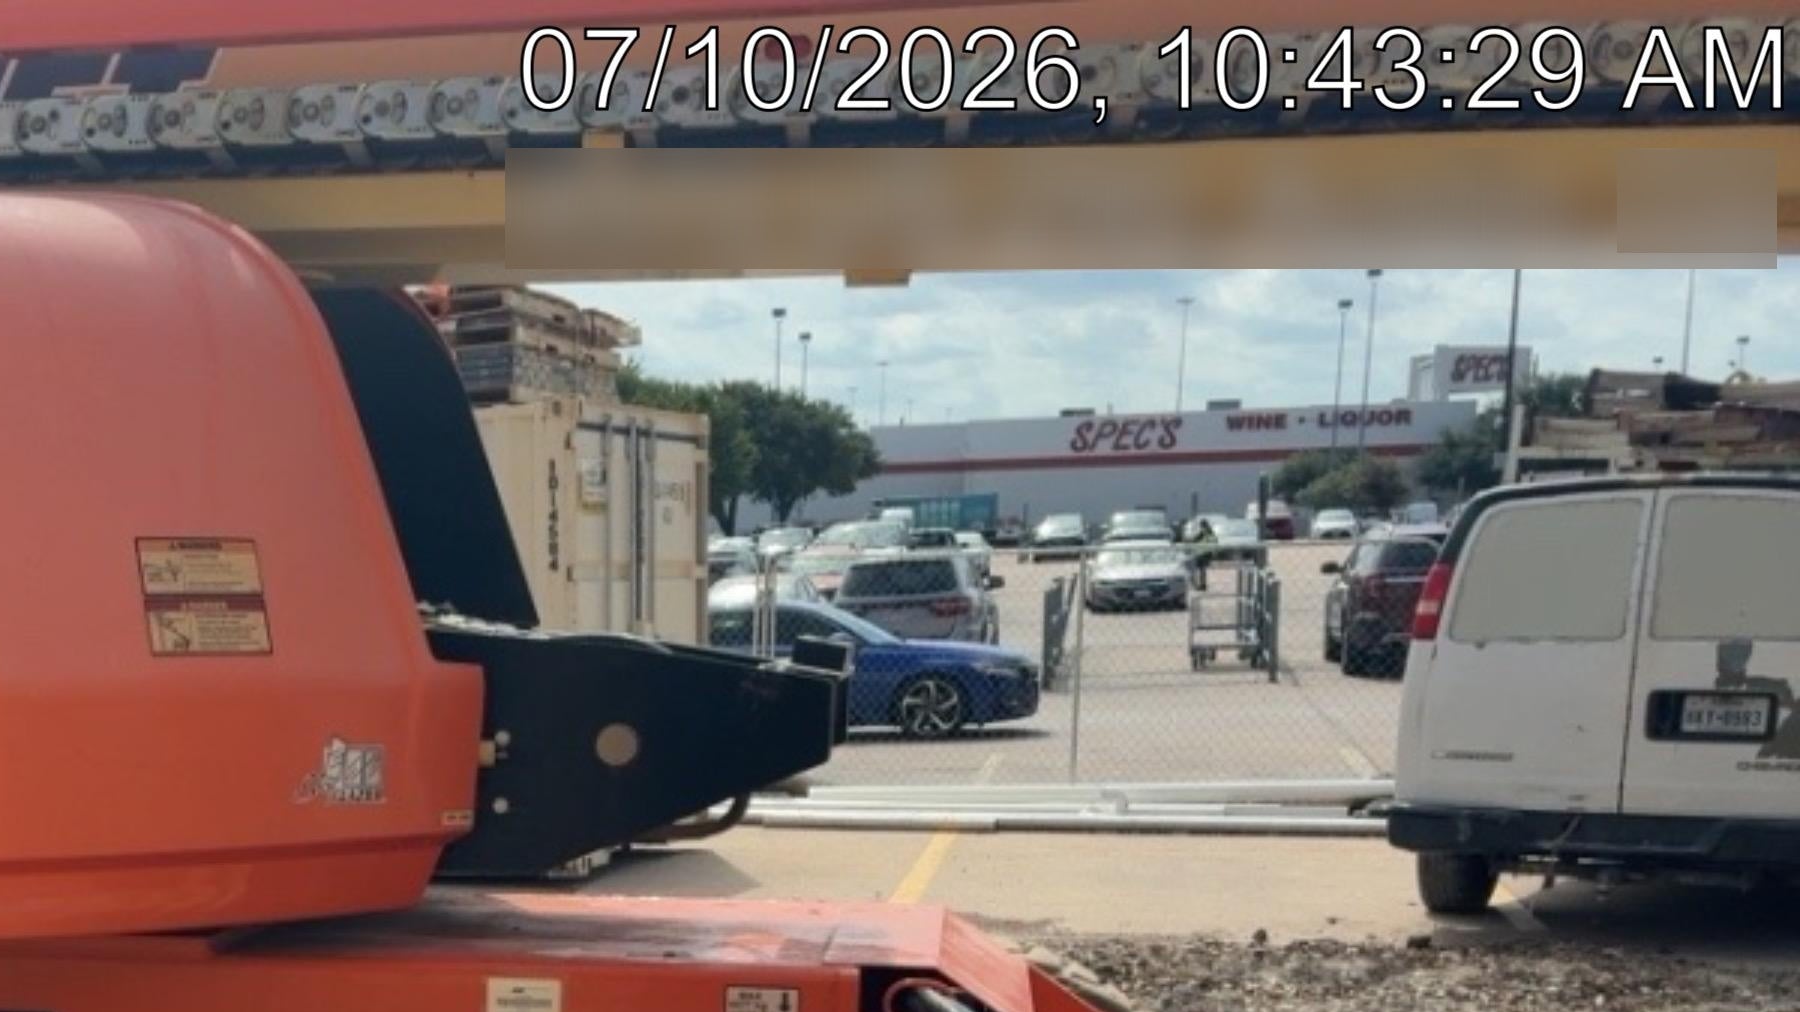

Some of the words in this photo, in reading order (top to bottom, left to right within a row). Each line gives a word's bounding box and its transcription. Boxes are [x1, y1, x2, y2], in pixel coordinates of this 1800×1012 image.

[1070, 415, 1183, 453] SPEC'S
[1226, 413, 1288, 431] WINE
[1318, 408, 1413, 427] LIQUOR
